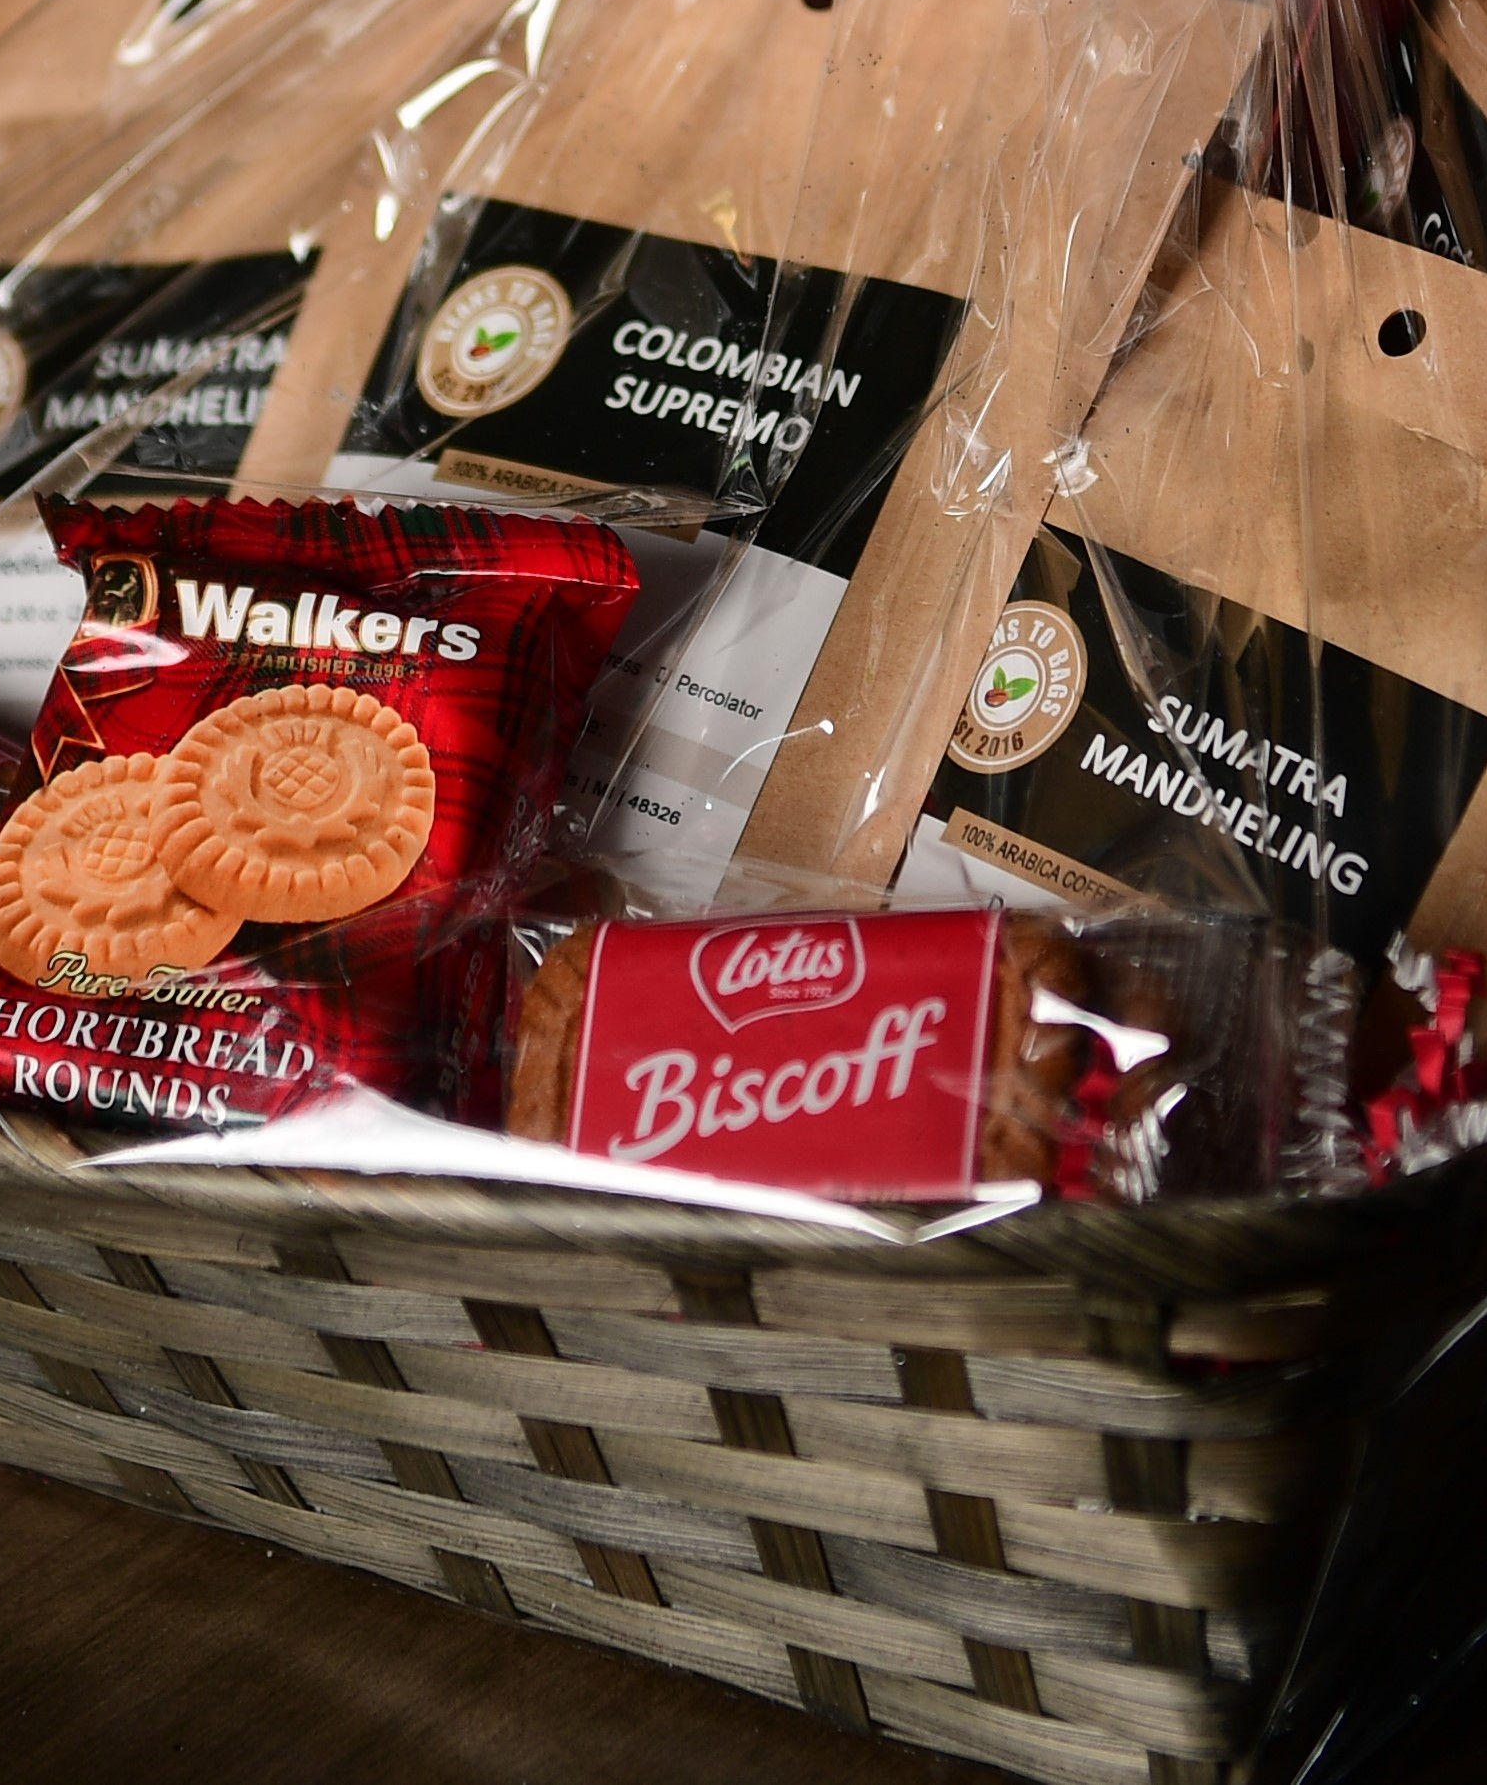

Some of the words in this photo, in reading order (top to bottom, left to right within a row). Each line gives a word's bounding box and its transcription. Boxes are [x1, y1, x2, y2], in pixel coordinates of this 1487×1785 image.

[612, 319, 862, 408] COLOMBIAN
[41, 382, 271, 431] MANDHELI
[604, 373, 812, 453] SUPREMO
[176, 579, 480, 661] Walkers
[1028, 619, 1056, 650] TO
[227, 650, 356, 676] ESTABLISHED
[362, 663, 405, 679] 1898
[675, 674, 763, 721] Percolator
[1040, 648, 1071, 717] BAGS
[975, 730, 1024, 758] 2016
[1147, 694, 1348, 817] SUMATRA
[627, 795, 682, 826] 48326
[1080, 733, 1370, 897] MANDHELING
[961, 823, 996, 853] 100%
[996, 840, 1062, 884] ARABICA
[36, 950, 130, 999] Pure
[717, 929, 846, 996] Lotus
[13, 1054, 232, 1127] ROUNDS
[607, 997, 948, 1163] Biscoff
